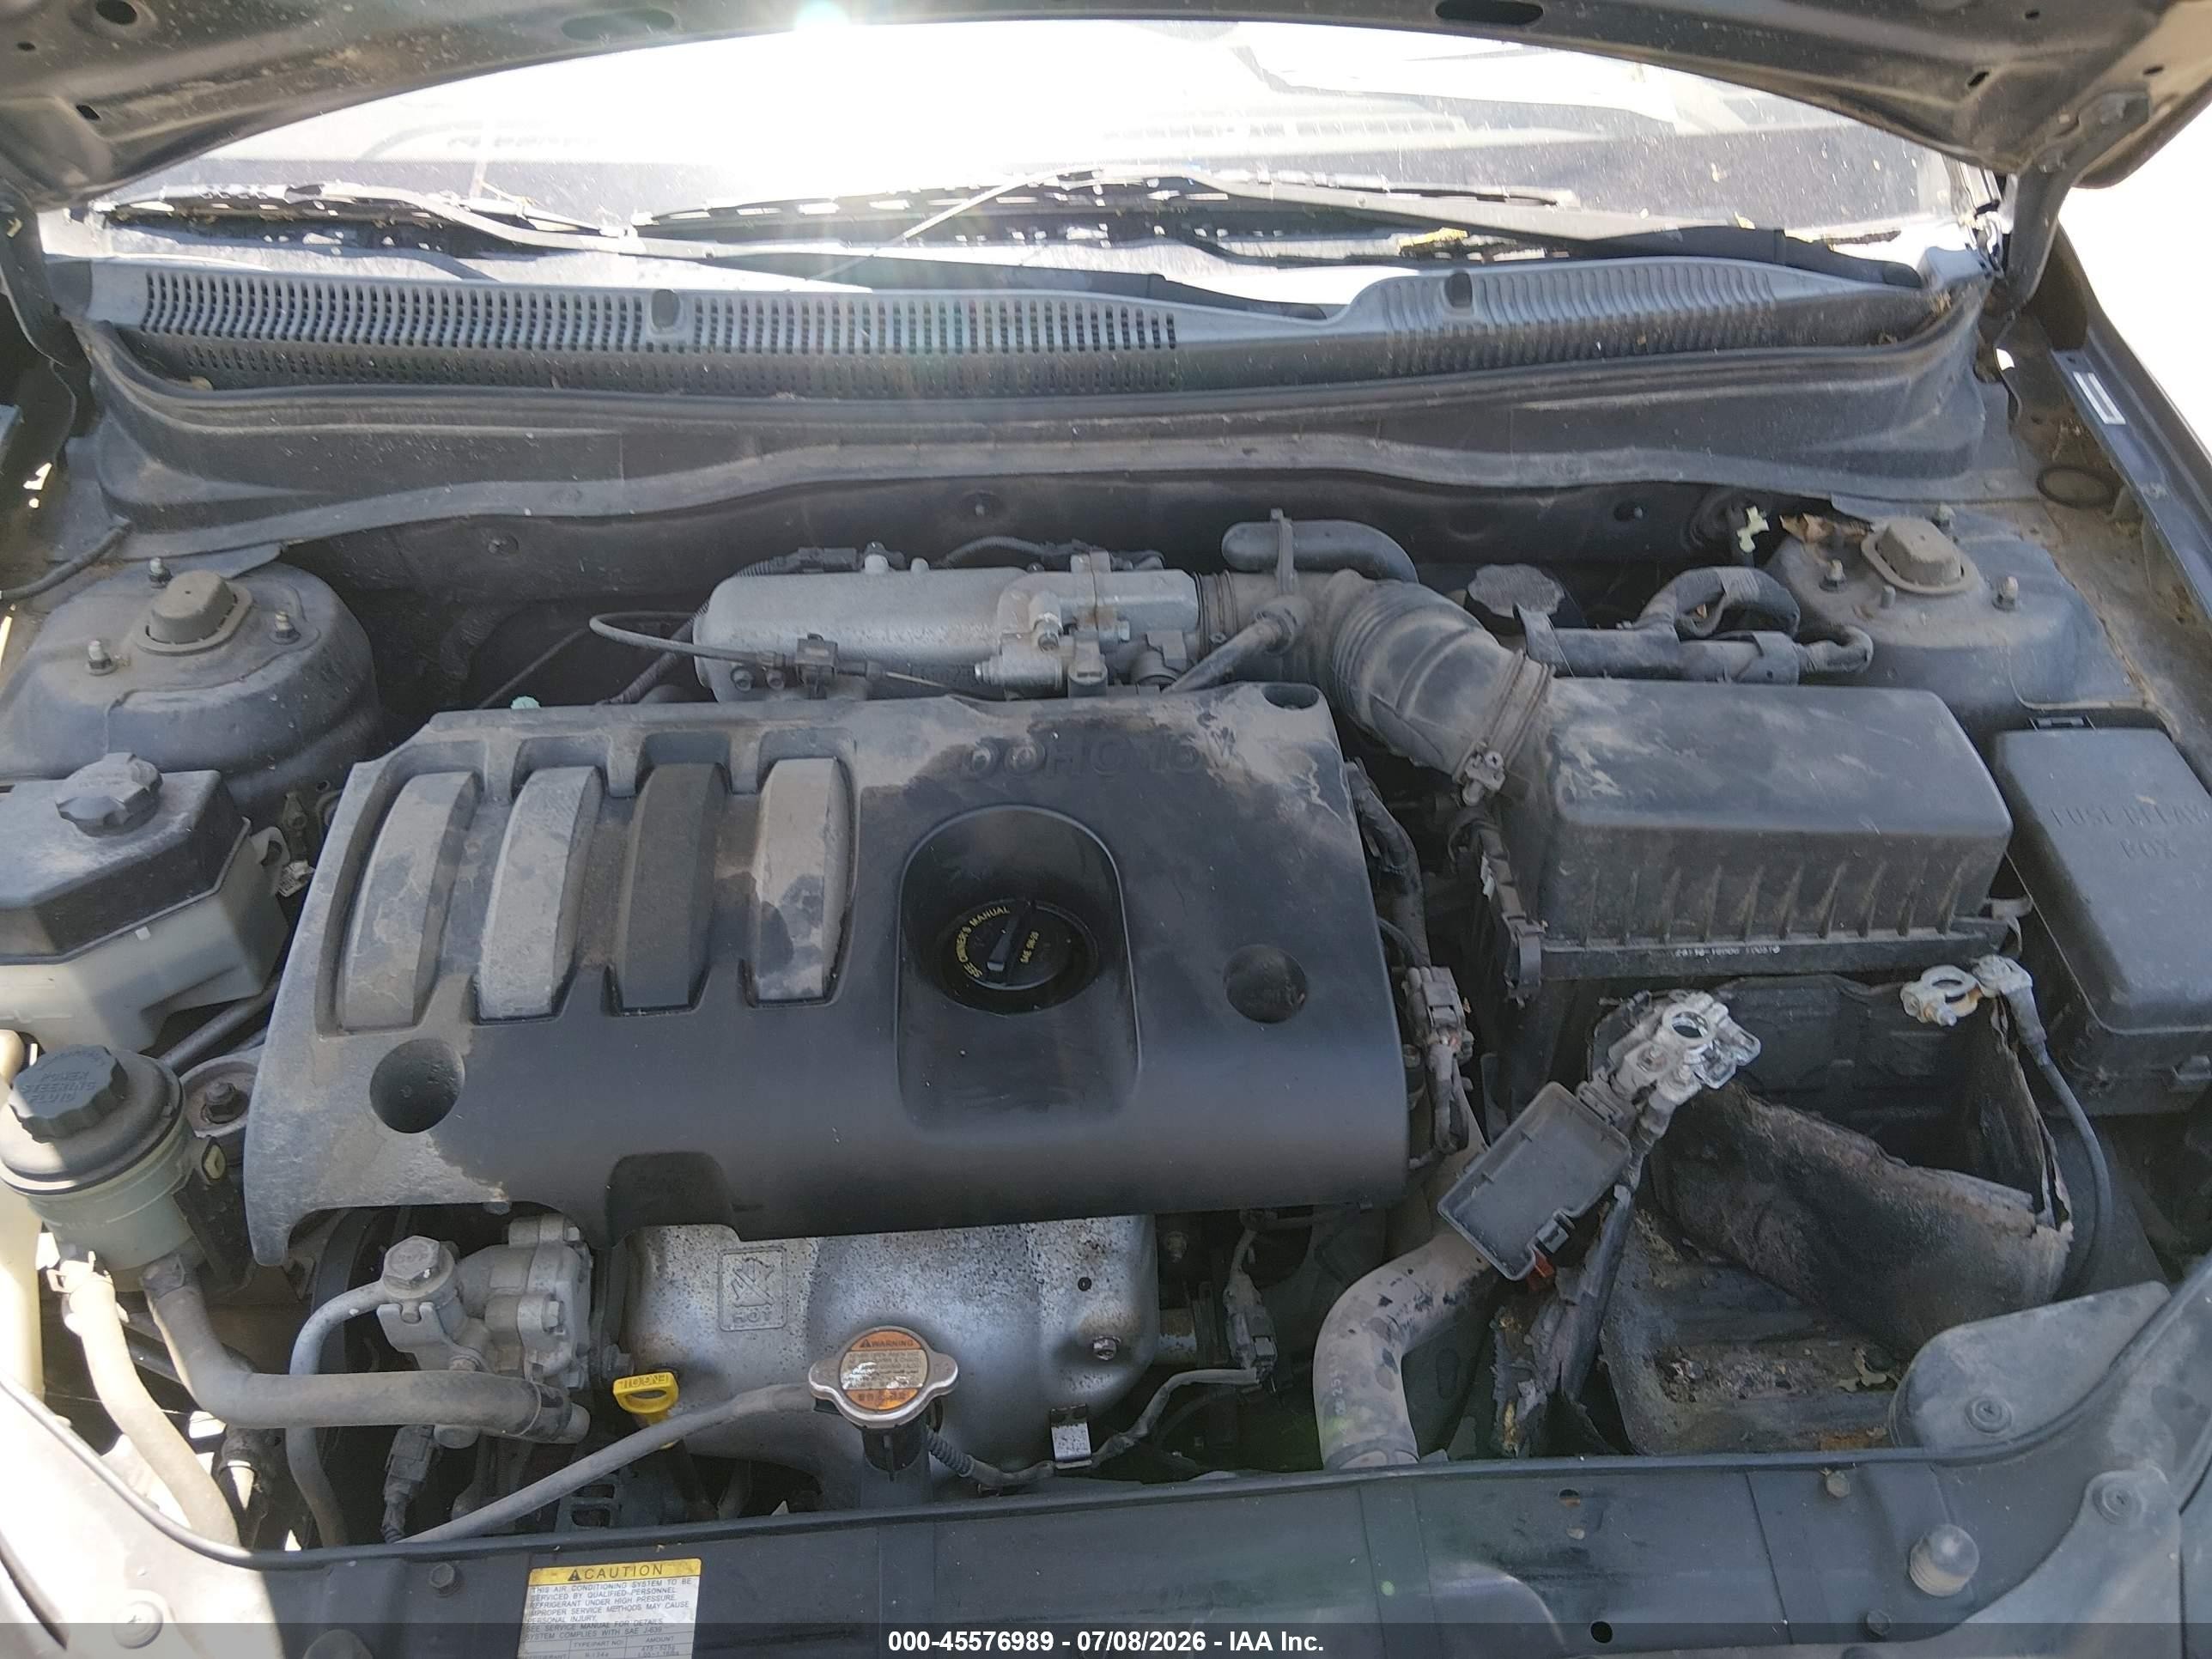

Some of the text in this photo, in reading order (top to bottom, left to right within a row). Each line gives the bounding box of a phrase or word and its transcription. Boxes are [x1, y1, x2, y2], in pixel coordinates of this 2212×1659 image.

[2118, 838, 2178, 860] BOX
[969, 906, 1010, 927] MANUAL
[732, 1310, 772, 1323] HOT
[874, 1340, 914, 1348] WARNING
[643, 1374, 668, 1385] ENG
[585, 1563, 663, 1579] CAUTION
[571, 1582, 627, 1592] CONDITIONING
[632, 1578, 662, 1589] SYSTEM
[530, 1593, 568, 1602] SERVICED
[587, 1589, 627, 1599] QUALIFIED
[632, 1586, 676, 1595] PERSONNEL
[530, 1600, 581, 1609] REFRIGERANT
[585, 1598, 611, 1607] UNDER
[636, 1594, 676, 1602] PRESSURE
[571, 1607, 603, 1615] SERVICE
[606, 1603, 642, 1613] METHODS
[665, 1601, 690, 1609] CAUSE
[526, 1625, 541, 1633] SEE
[545, 1623, 576, 1632] SERVICE
[580, 1620, 611, 1629] MANUAL
[614, 1620, 629, 1628] FOR
[524, 1632, 556, 1642] SYSTEM
[559, 1631, 598, 1639] COMPLIES
